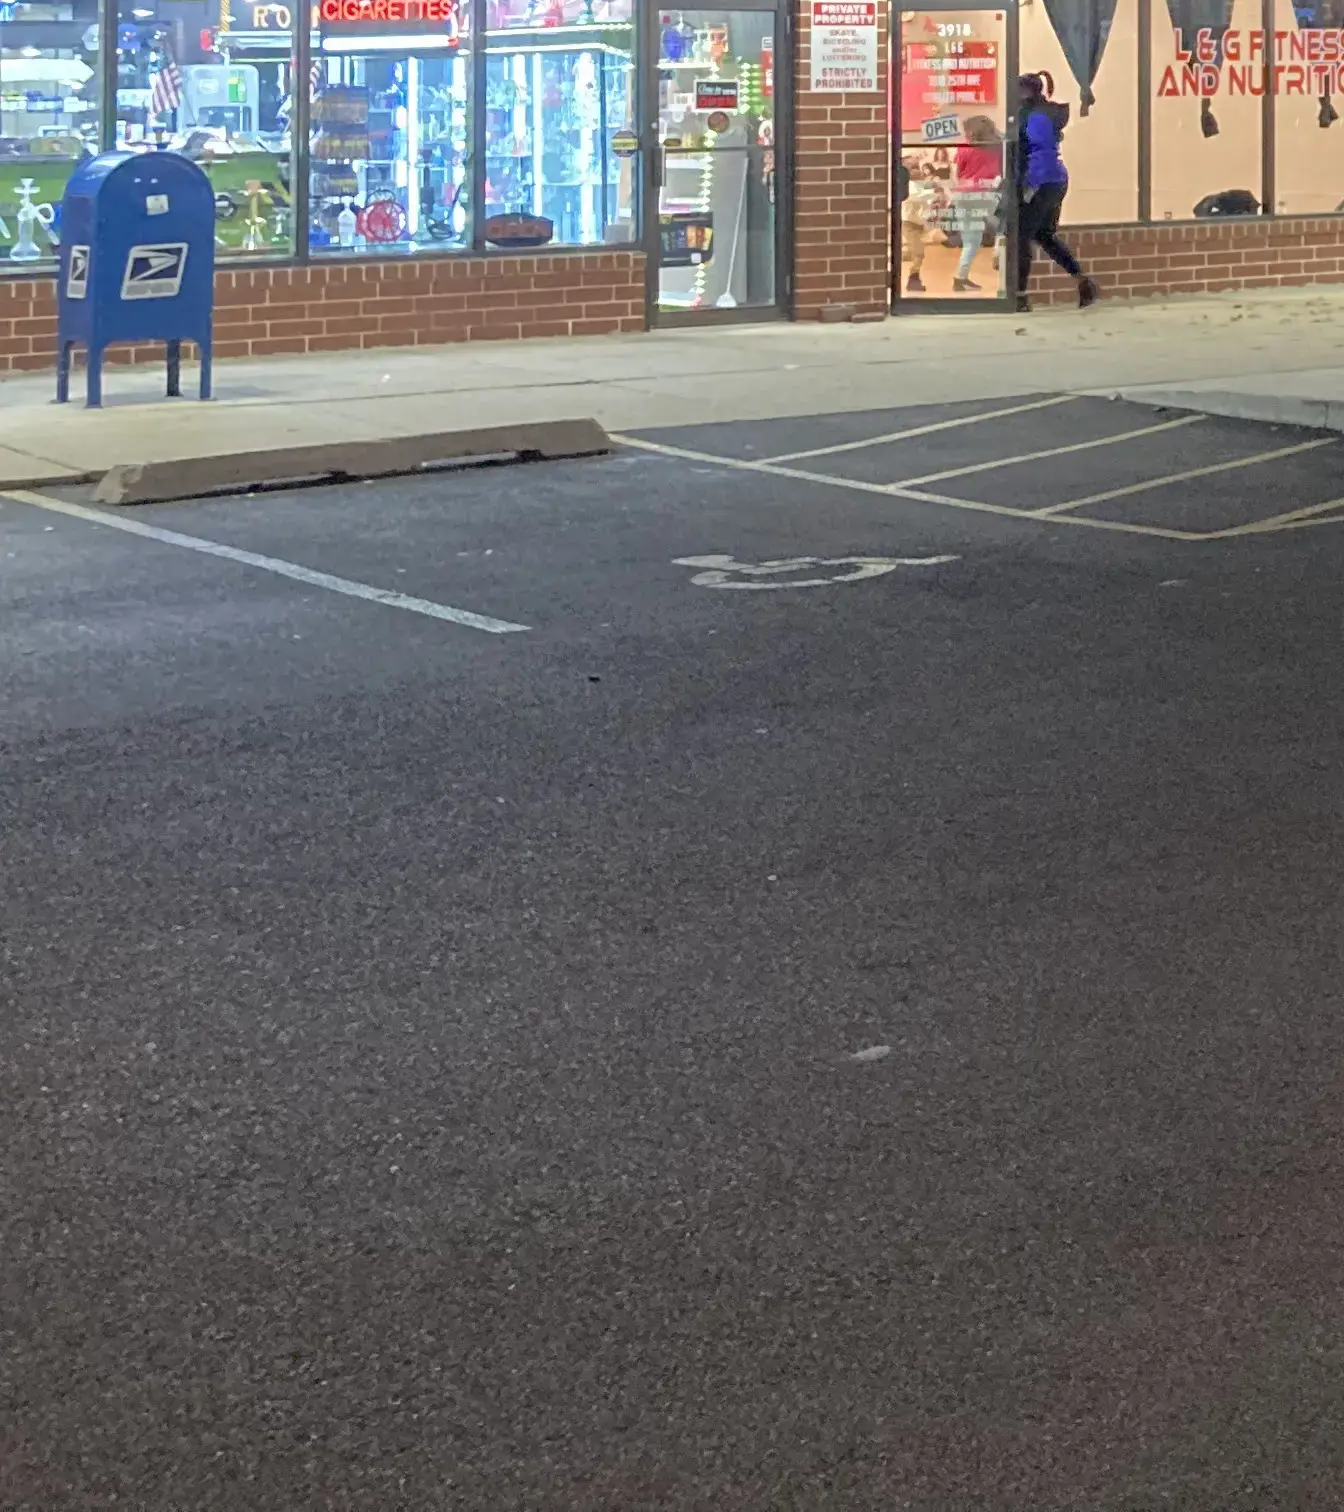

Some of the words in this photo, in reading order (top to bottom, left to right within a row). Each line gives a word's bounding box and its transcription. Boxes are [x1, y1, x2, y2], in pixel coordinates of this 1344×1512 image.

[820, 4, 867, 14] PRIVATE
[814, 14, 874, 25] PROPERTY
[1174, 27, 1193, 62] L
[1196, 27, 1218, 63] &
[1222, 29, 1242, 62] G
[821, 68, 868, 78] STRICTLY
[815, 78, 873, 89] PROHIBITED
[1156, 64, 1221, 97] AND
[924, 119, 959, 138] OPEN
